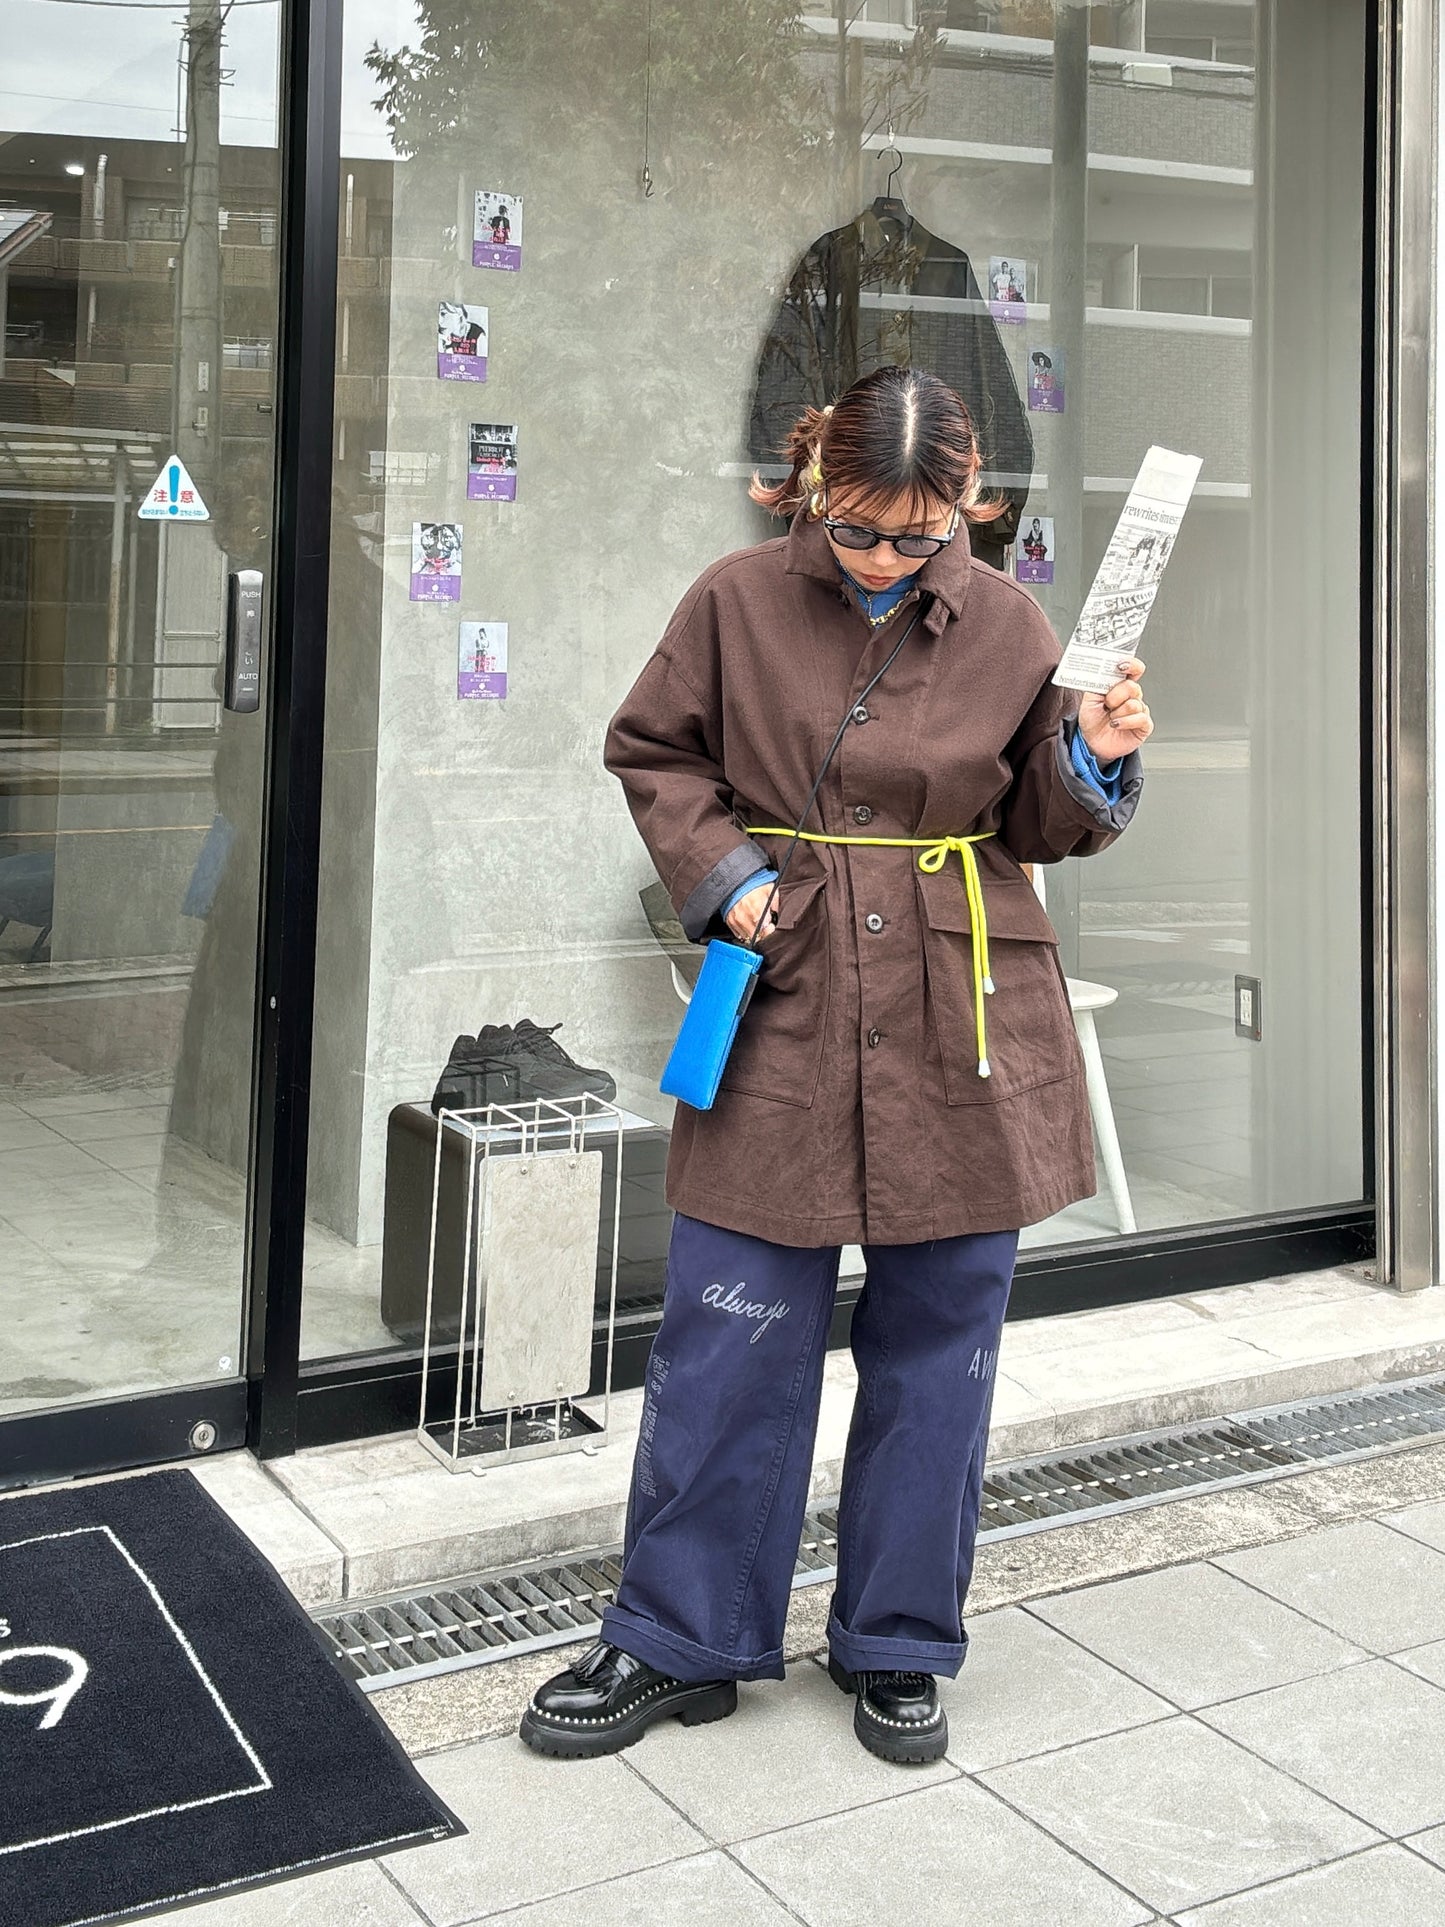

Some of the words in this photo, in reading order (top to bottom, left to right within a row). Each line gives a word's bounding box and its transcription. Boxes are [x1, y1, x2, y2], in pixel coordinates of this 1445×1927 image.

[1123, 505, 1160, 522] rewrites
[241, 590, 261, 598] PUSH
[238, 672, 259, 680] AUTO
[701, 1281, 790, 1344] always
